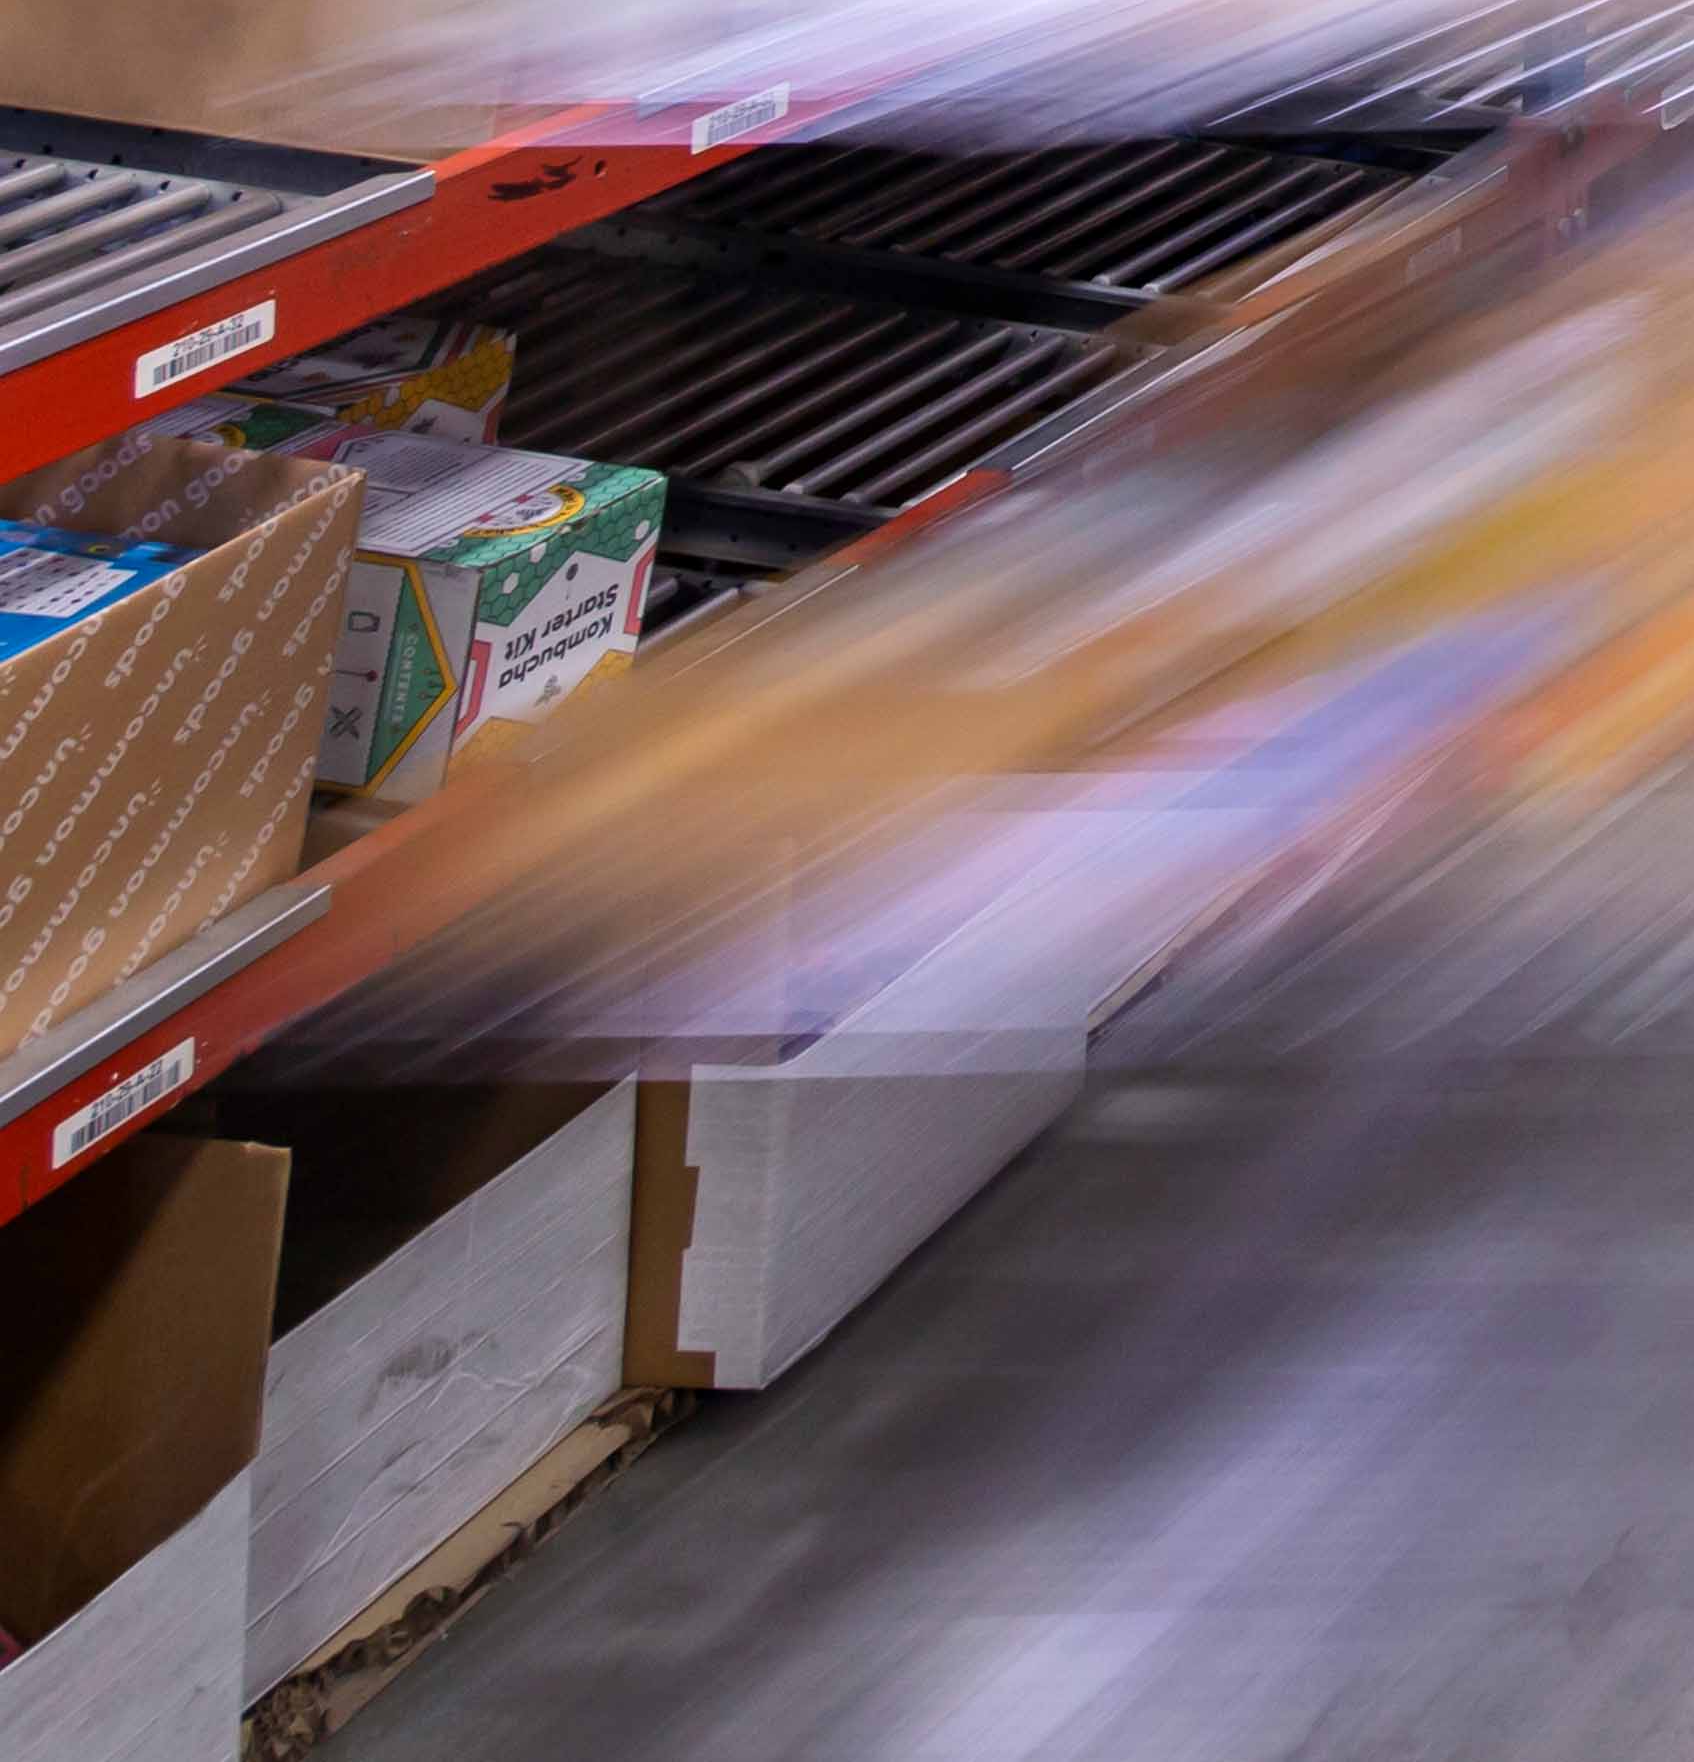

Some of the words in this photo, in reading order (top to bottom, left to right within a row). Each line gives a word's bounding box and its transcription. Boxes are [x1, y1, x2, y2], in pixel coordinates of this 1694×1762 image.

[60, 433, 154, 513] goods
[104, 571, 187, 690] goods
[498, 613, 615, 689] Kombucha
[503, 628, 538, 661] Kit
[541, 583, 620, 636] Starter
[173, 628, 256, 744] goods
[396, 634, 419, 724] CONTENTS
[35, 646, 195, 865] uncommon
[239, 683, 315, 800] goods
[108, 701, 260, 918] uncommon
